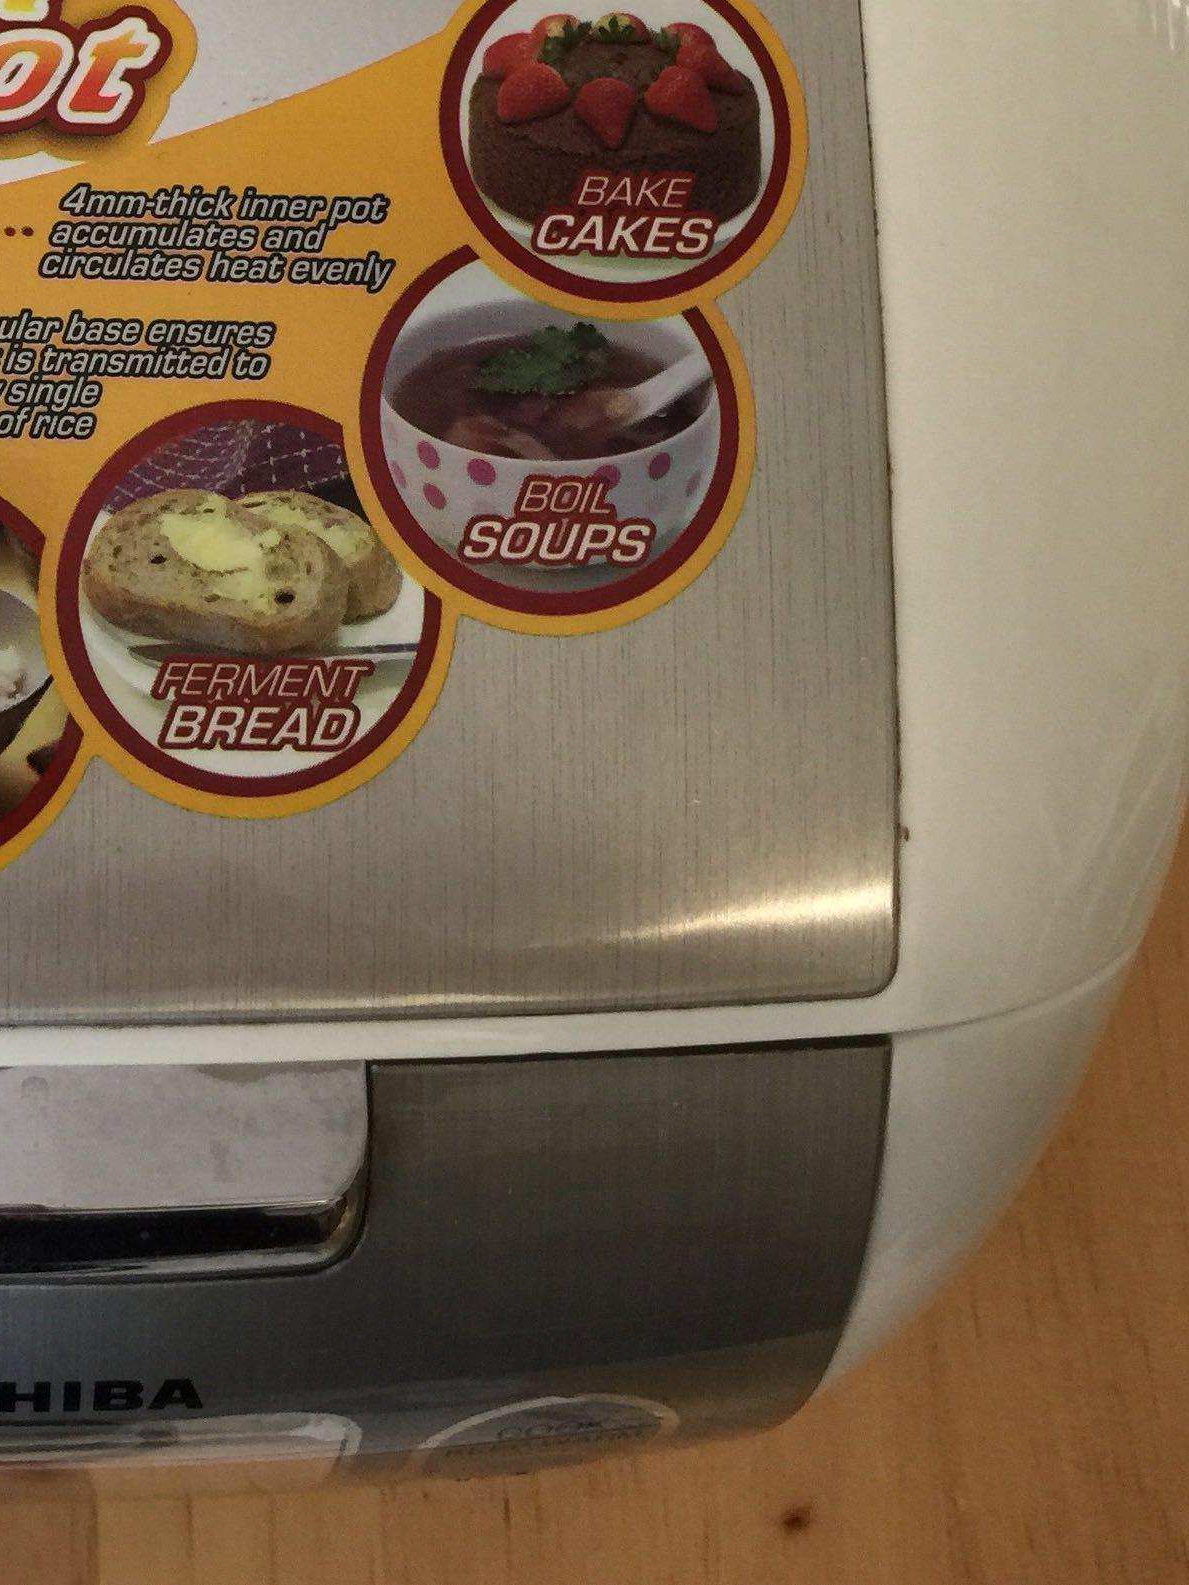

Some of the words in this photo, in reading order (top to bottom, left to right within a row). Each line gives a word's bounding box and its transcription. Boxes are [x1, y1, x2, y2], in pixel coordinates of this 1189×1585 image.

[239, 190, 323, 221] inner
[329, 193, 387, 225] pot
[577, 175, 693, 209] BAKE
[50, 220, 258, 251] accumulates
[265, 223, 326, 252] and
[536, 213, 714, 255] CAKES
[41, 249, 201, 280] circulates
[209, 251, 285, 281] heat
[290, 254, 394, 290] evenly
[66, 312, 140, 344] base
[149, 321, 275, 347] ensures
[4, 345, 33, 374] is
[40, 346, 226, 378] transmitted
[234, 350, 270, 378] to
[9, 376, 100, 410] single
[32, 409, 94, 438] rice
[518, 480, 611, 515] BOIL
[462, 520, 651, 562] SOUPS
[157, 662, 370, 700] FERMENT
[164, 703, 361, 748] BREAD
